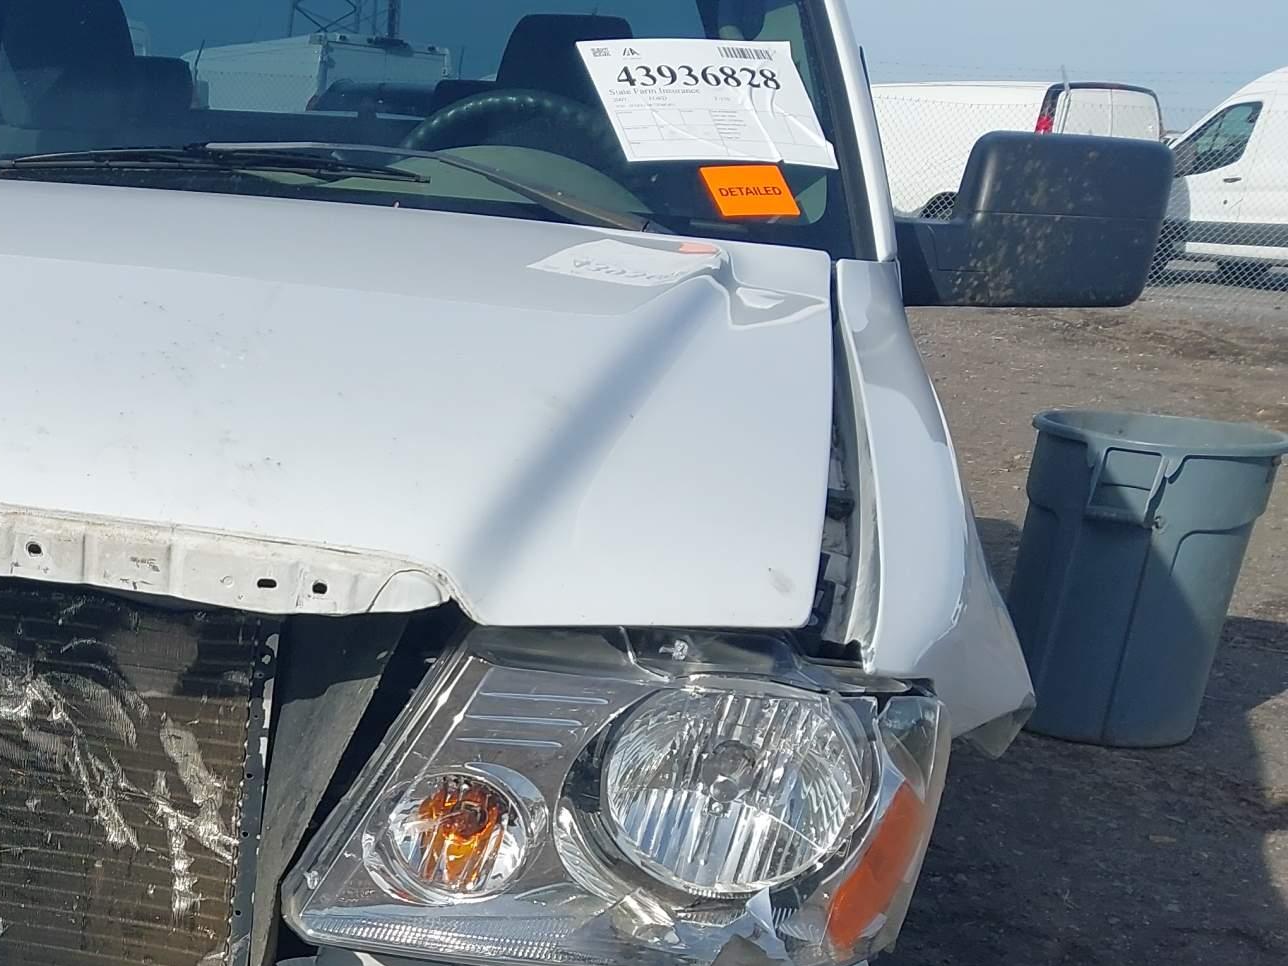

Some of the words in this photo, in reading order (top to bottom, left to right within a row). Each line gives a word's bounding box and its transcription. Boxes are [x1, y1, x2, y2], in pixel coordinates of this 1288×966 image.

[616, 64, 781, 91] 43936828
[609, 88, 632, 96] State
[633, 87, 657, 95] Farm
[658, 86, 700, 95] Insurance
[718, 186, 782, 197] DETAILED
